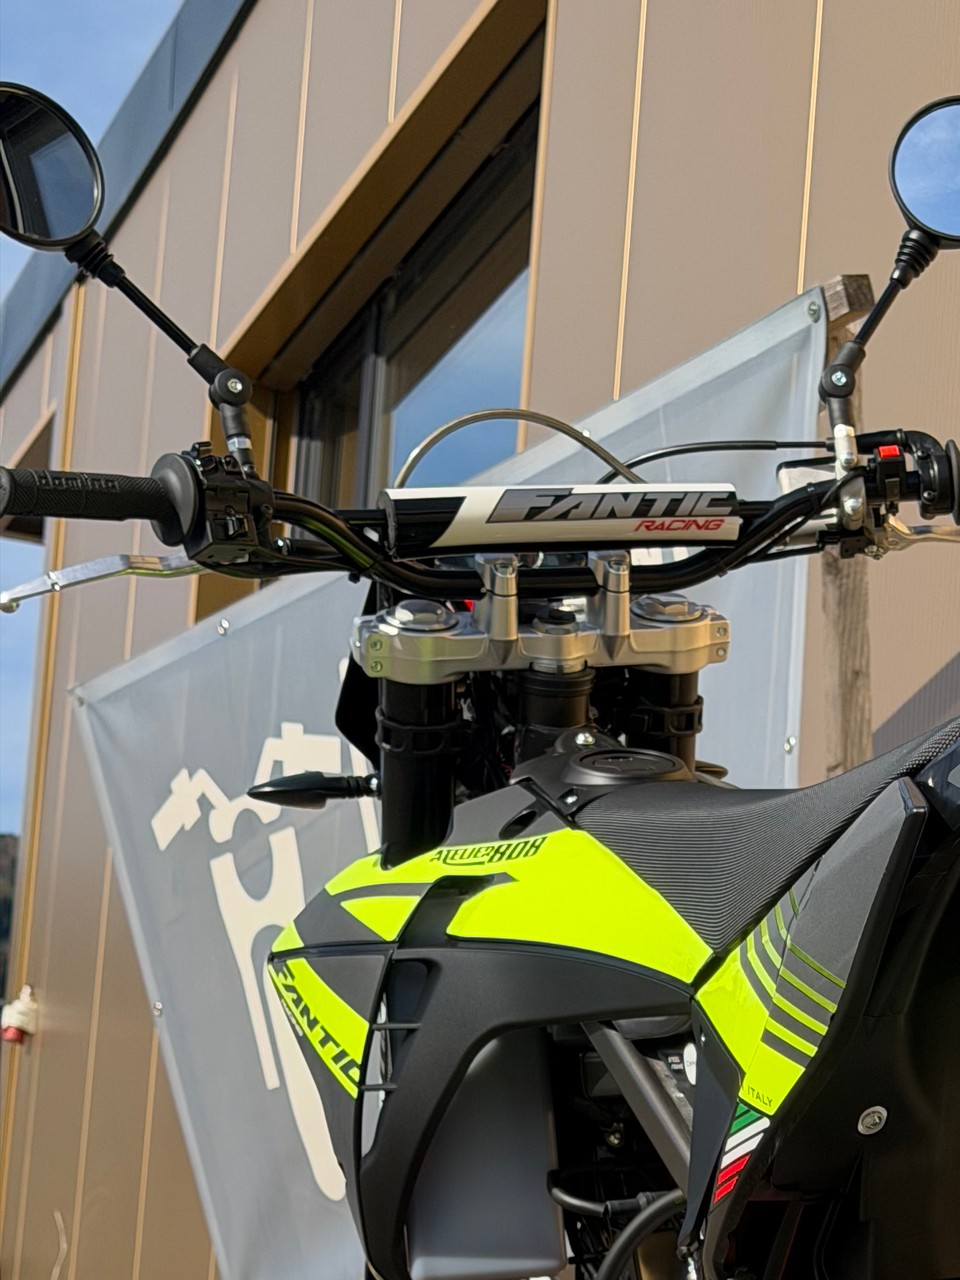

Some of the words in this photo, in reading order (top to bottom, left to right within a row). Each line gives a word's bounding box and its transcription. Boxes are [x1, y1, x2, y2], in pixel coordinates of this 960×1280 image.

[485, 488, 733, 524] FANTIC
[634, 518, 726, 533] RACING
[747, 1086, 774, 1108] ITALY
